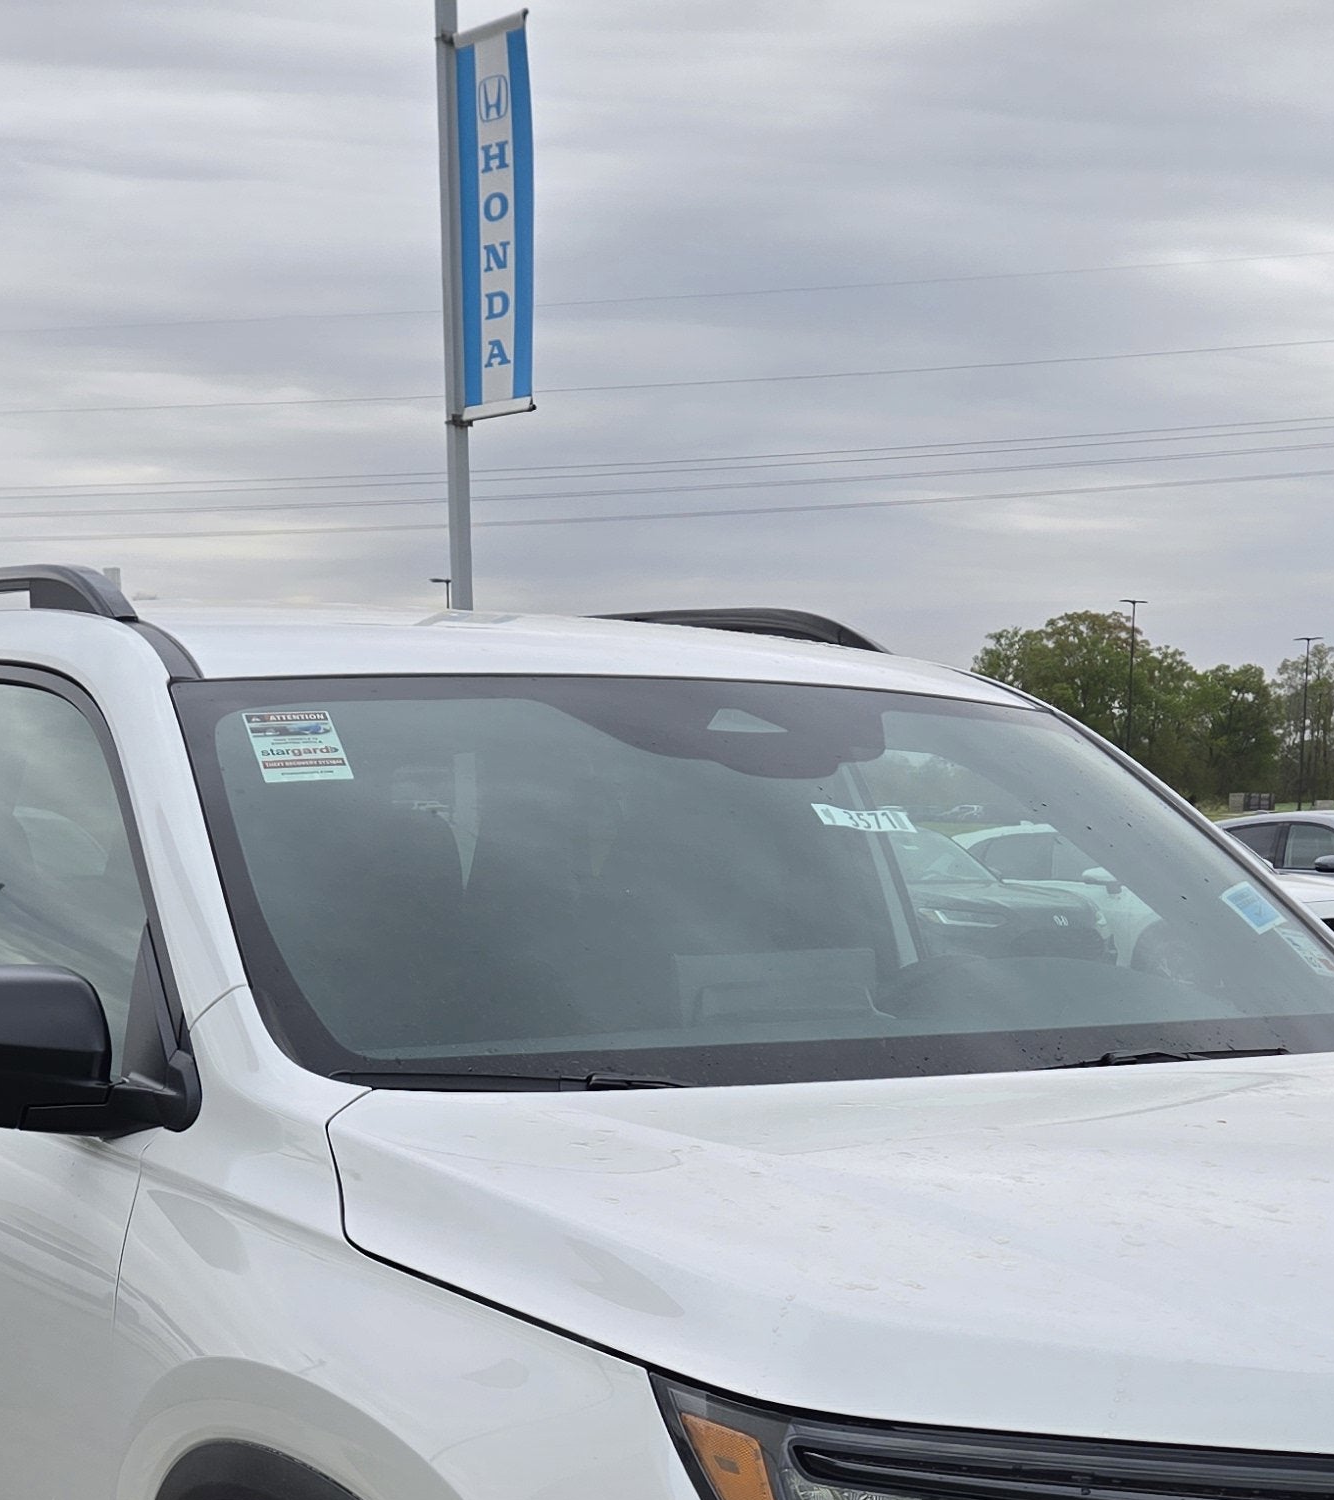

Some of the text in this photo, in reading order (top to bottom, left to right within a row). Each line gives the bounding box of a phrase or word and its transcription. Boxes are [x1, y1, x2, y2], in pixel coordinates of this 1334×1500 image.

[481, 140, 511, 369] HONDA
[269, 713, 325, 721] ATTENTION
[261, 745, 332, 757] stargard
[843, 811, 898, 830] 3571
